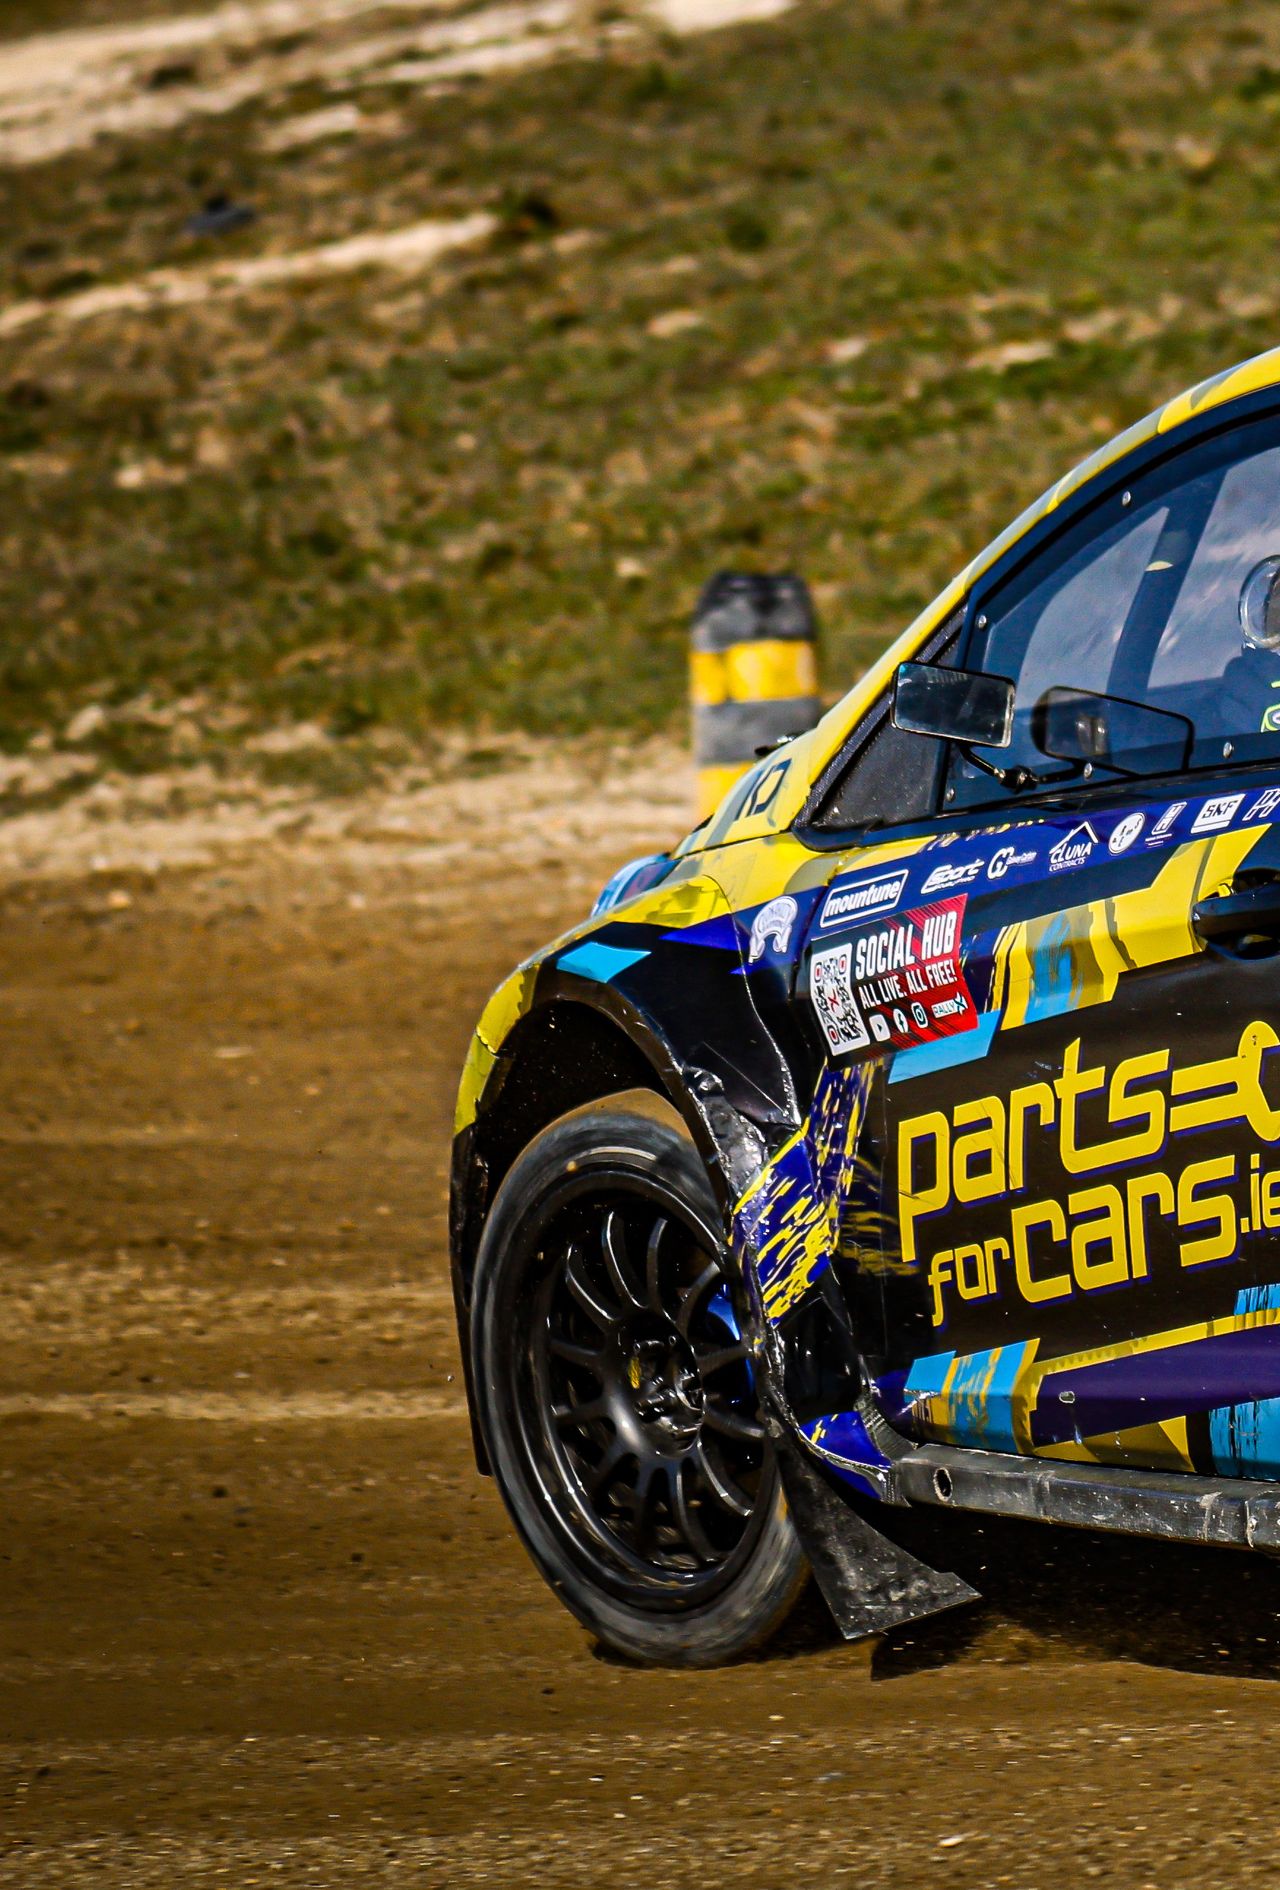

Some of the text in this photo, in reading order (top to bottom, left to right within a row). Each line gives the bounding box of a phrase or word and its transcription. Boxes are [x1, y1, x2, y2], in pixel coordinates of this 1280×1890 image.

[1201, 799, 1238, 819] SKF
[824, 879, 902, 918] mountune
[855, 910, 958, 980] SOCIAL HUB
[858, 983, 882, 1010] ALL
[905, 968, 928, 995] ALL
[924, 958, 958, 989] FREE!
[899, 1037, 1167, 1263] parts
[927, 1237, 1011, 1327] for
